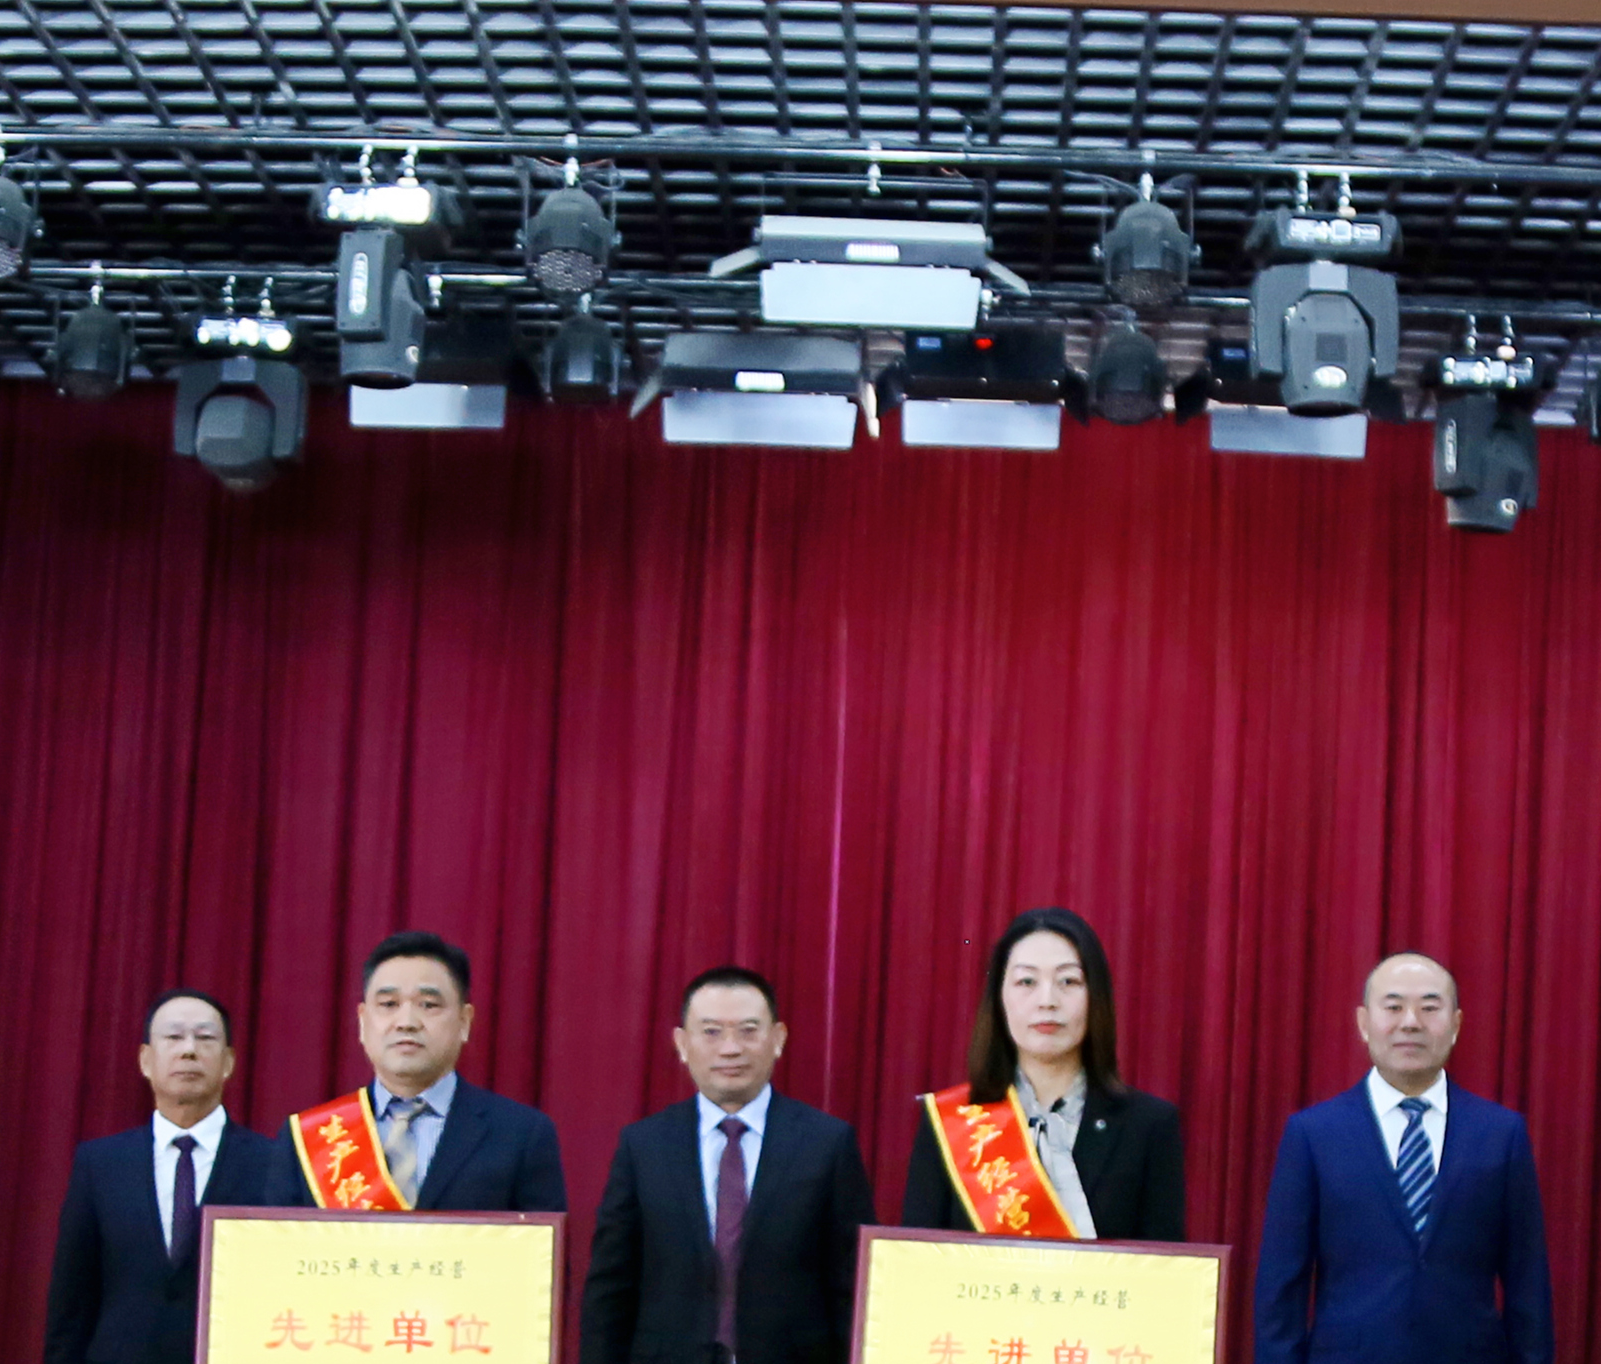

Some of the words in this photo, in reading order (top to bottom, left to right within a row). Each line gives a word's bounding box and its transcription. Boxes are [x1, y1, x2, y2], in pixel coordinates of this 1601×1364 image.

[319, 1114, 385, 1210] 生产经
[957, 1104, 1032, 1236] 生产经营
[297, 1257, 467, 1280] 2025年度生产经营
[957, 1283, 1131, 1310] 2025年度生产经营
[265, 1309, 493, 1356] 先进单位
